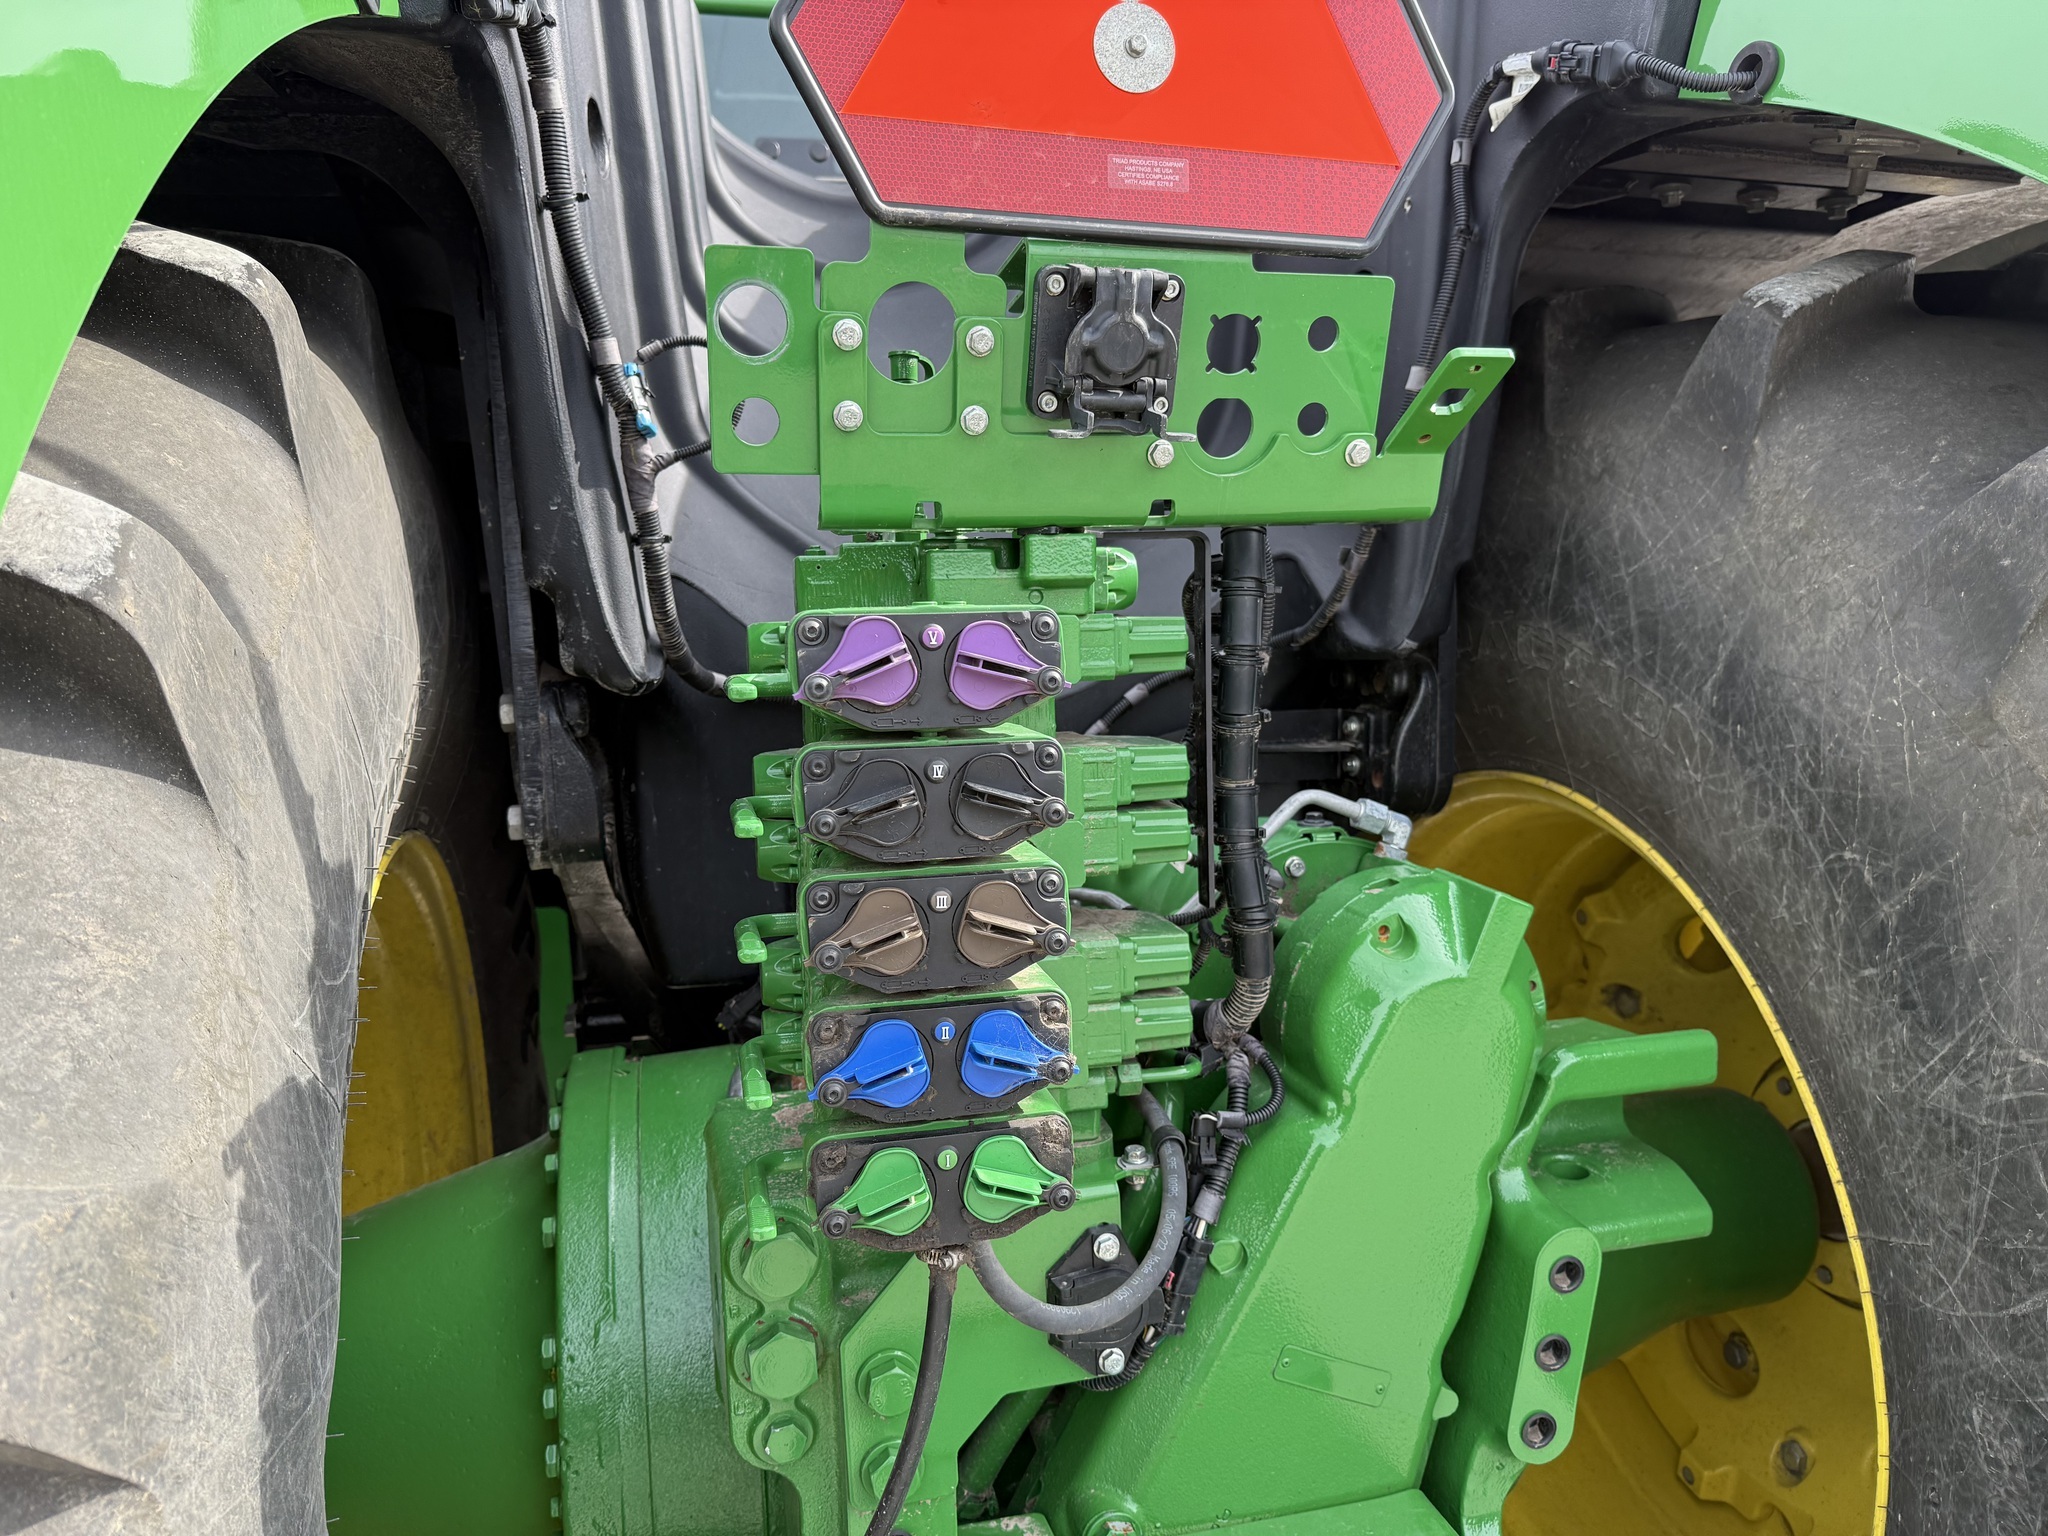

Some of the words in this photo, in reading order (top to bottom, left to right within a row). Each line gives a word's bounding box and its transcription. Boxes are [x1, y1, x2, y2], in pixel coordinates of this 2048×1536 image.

[1112, 157, 1128, 165] TRIAD
[1129, 158, 1158, 167] PRODUCTS
[1159, 161, 1185, 169] COMPANY
[1124, 165, 1153, 173] HASTINGS,
[1145, 173, 1180, 181] COMPLIANCE
[927, 630, 938, 645] V
[932, 764, 944, 778] IV
[935, 895, 948, 909] III
[941, 1026, 950, 1040] II
[945, 1154, 951, 1168] I
[1167, 1174, 1179, 1197] 100R6
[1155, 1208, 1177, 1251] 05/06/22
[1141, 1254, 1161, 1274] Made
[1130, 1276, 1144, 1285] in
[1113, 1285, 1133, 1301] USA
